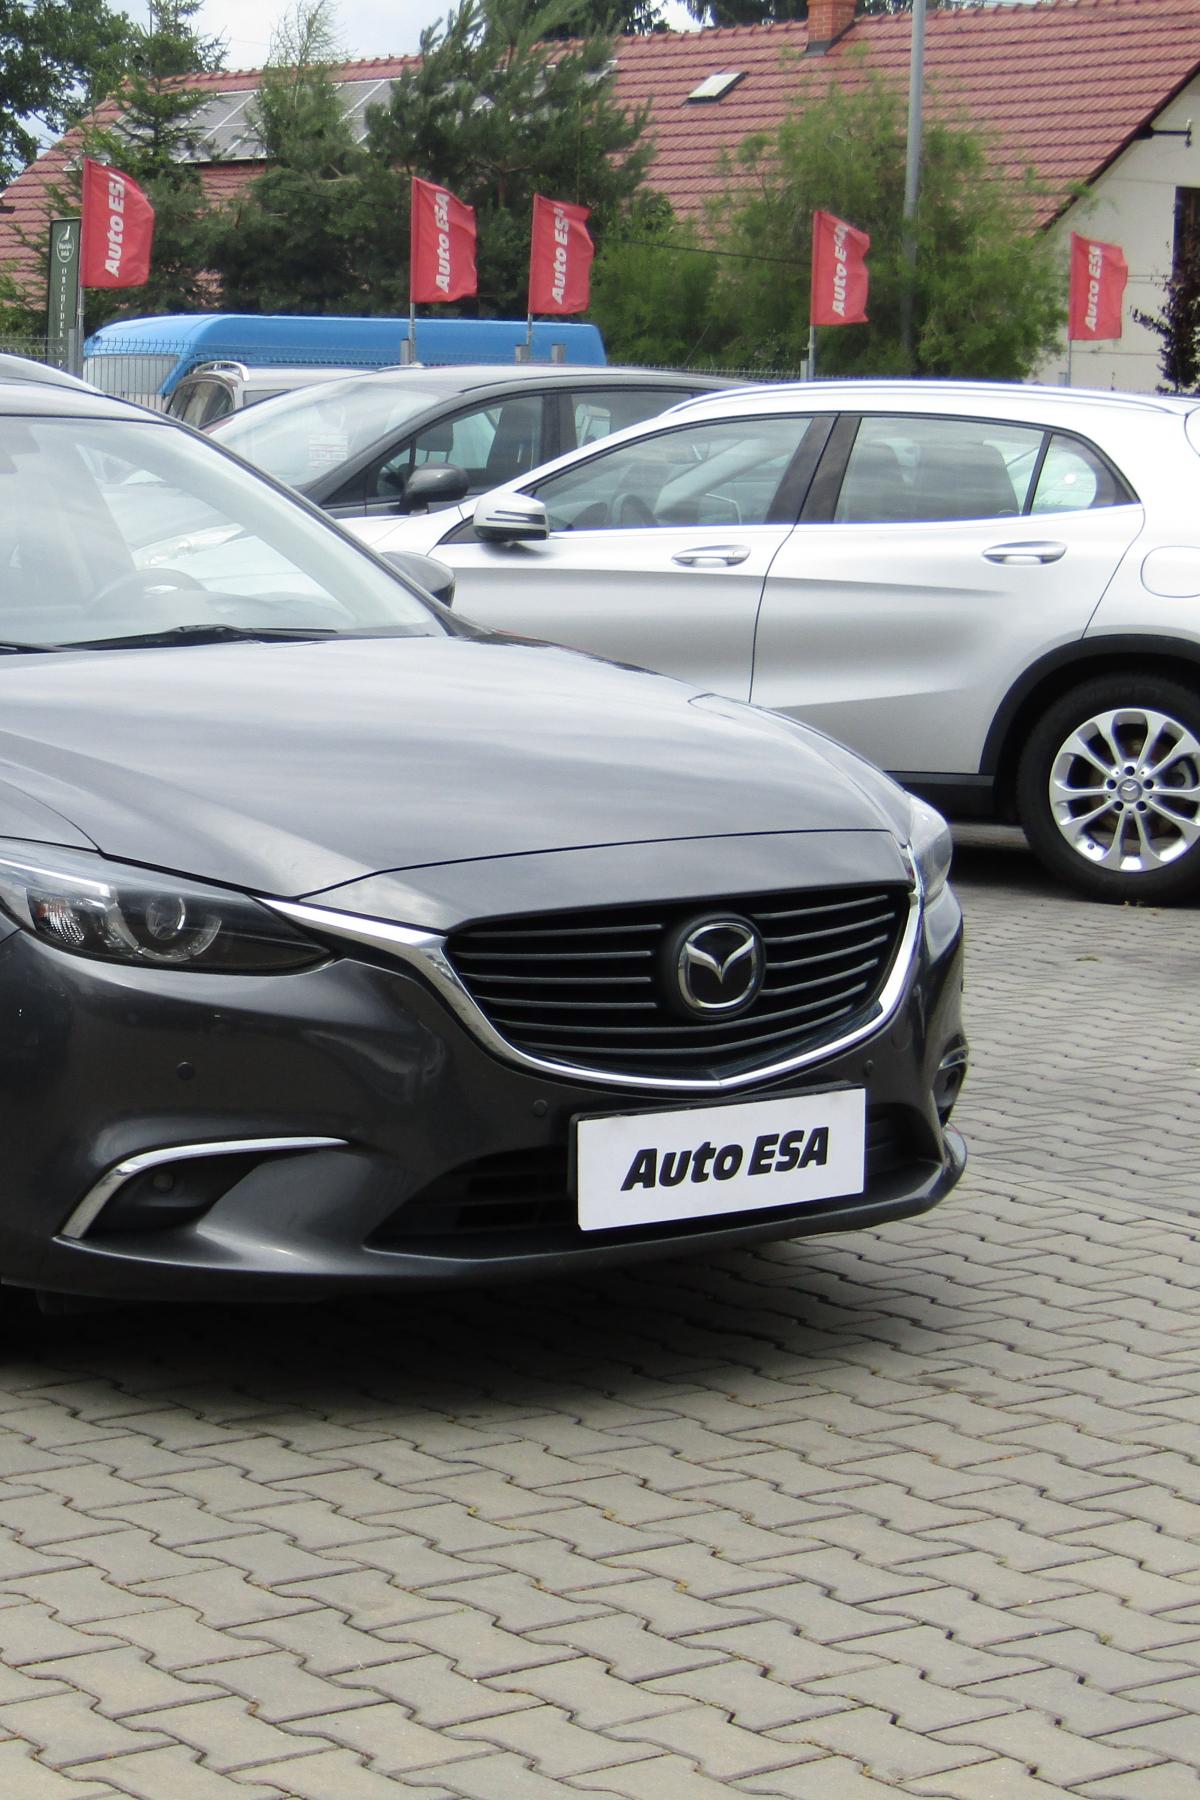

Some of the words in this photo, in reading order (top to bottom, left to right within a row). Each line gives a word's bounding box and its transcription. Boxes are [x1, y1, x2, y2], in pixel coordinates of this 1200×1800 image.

[434, 192, 450, 233] ESA
[105, 215, 124, 278] Auto
[435, 233, 450, 293] Auto
[552, 247, 567, 304] Auto
[832, 263, 847, 317] Auto
[1085, 280, 1099, 332] Auto
[620, 1141, 744, 1191] Auto
[747, 1127, 829, 1176] ESA
